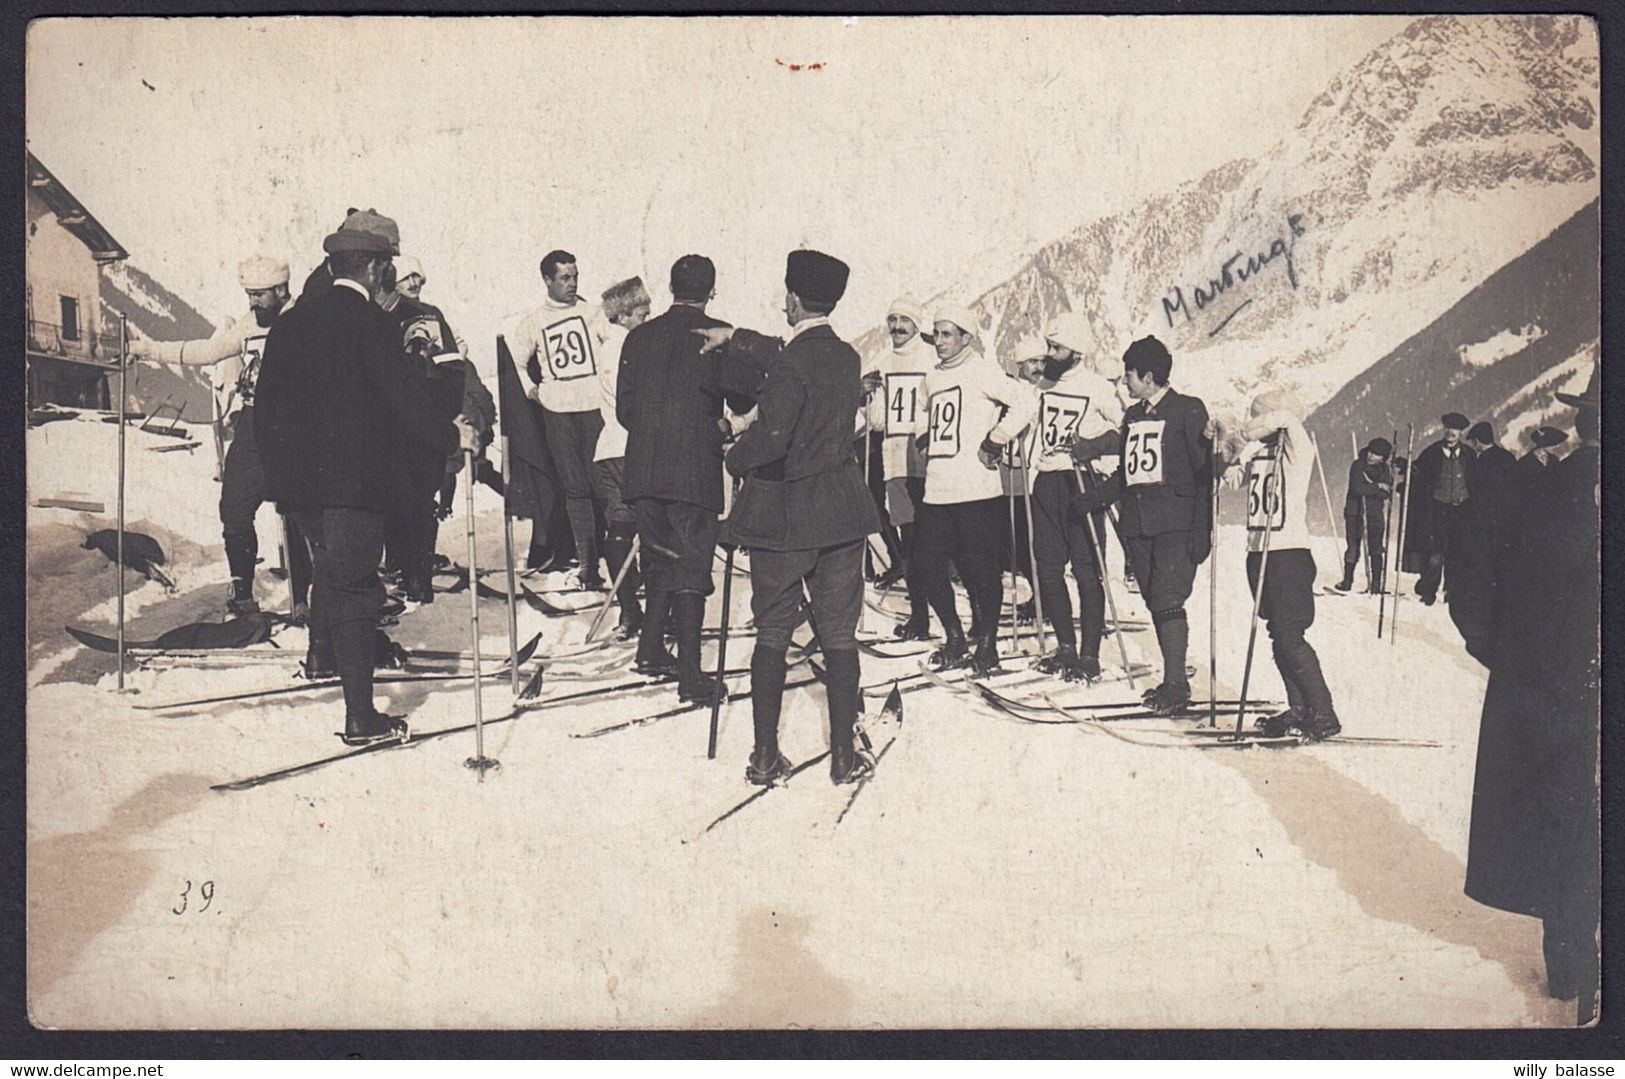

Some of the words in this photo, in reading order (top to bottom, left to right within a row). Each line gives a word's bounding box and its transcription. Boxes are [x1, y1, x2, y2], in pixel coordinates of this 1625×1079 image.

[549, 330, 586, 369] 39
[891, 387, 917, 422] 41
[932, 401, 955, 442] 42
[1127, 432, 1159, 475] 35
[1250, 473, 1279, 516] 36
